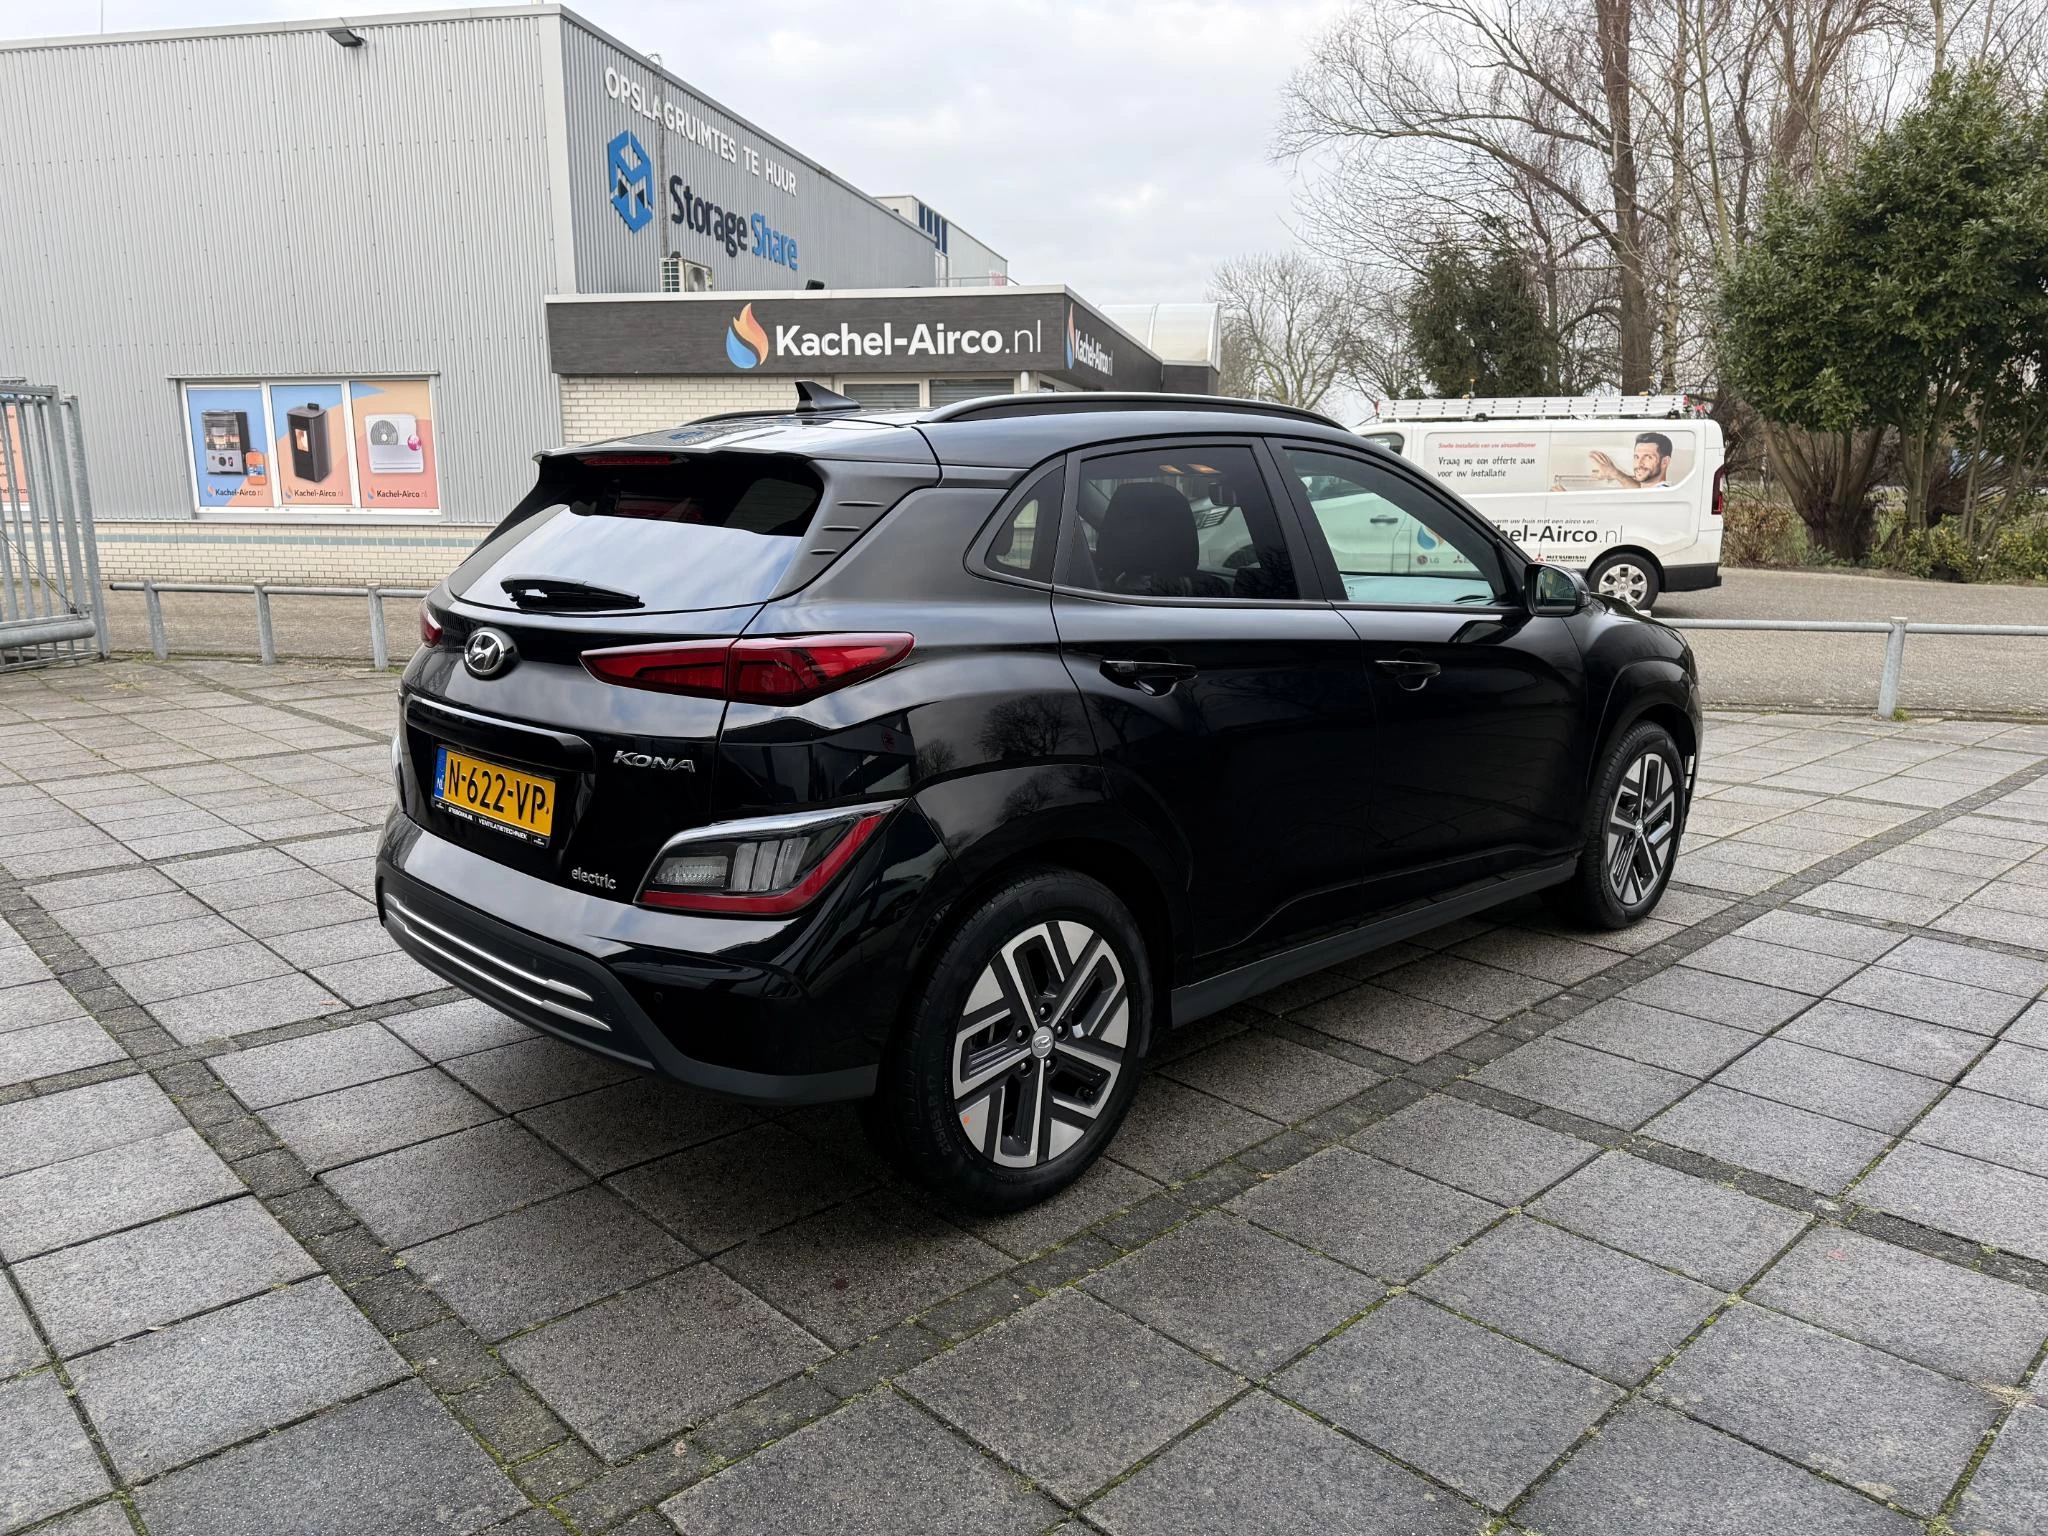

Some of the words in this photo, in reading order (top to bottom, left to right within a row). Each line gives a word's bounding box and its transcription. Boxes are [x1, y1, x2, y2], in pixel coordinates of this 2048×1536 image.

[605, 66, 737, 164] OPSLAGRUIMTES
[743, 145, 759, 175] TE
[766, 158, 797, 197] HUUR
[776, 319, 1042, 356] Kachel-Airco.nl
[1075, 328, 1113, 376] Kachel-Airco.nl
[1438, 456, 1460, 466] Vraag
[1492, 455, 1517, 465] offerte
[1470, 468, 1506, 477] installatie
[1497, 524, 1623, 543] hel-Airco.nl
[612, 750, 696, 773] KONA
[436, 775, 444, 790] NL
[448, 757, 547, 824] N-622-VP
[571, 866, 617, 890] electric
